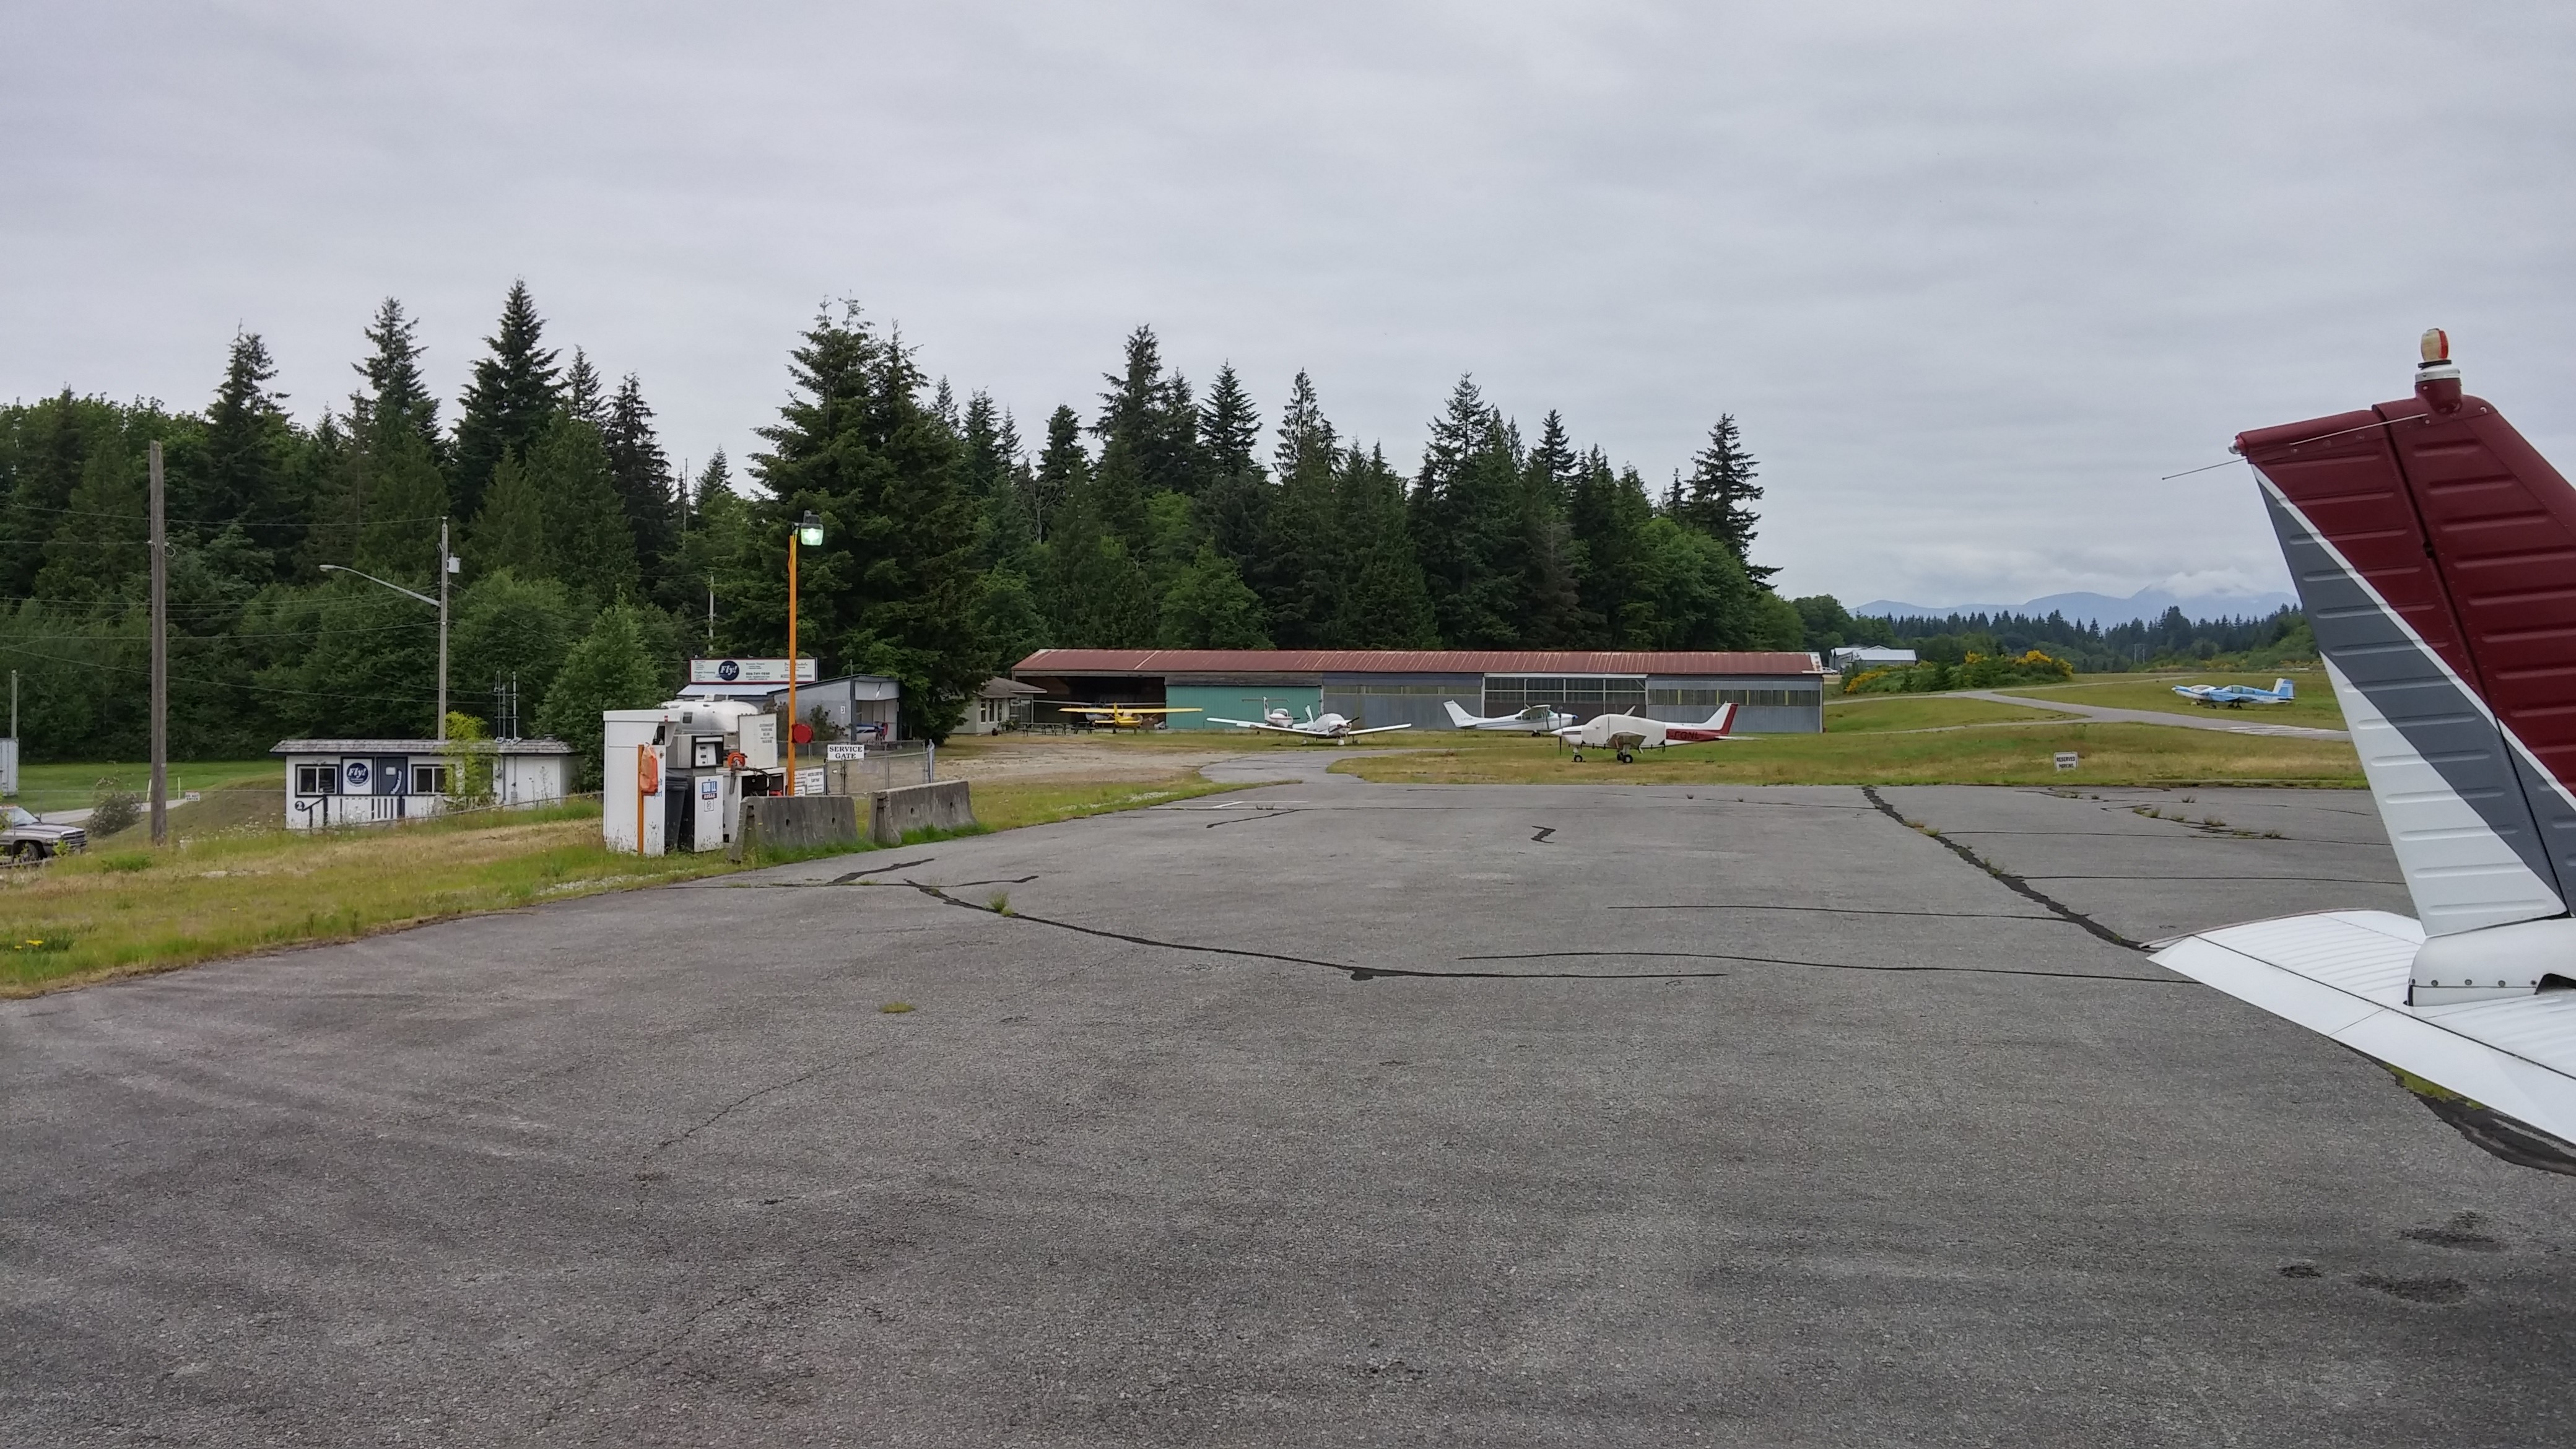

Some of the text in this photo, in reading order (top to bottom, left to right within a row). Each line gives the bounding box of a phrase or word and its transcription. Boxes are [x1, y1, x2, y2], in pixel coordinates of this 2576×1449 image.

[720, 664, 738, 676] Fly!
[348, 767, 367, 778] Fly!
[297, 801, 303, 809] 2
